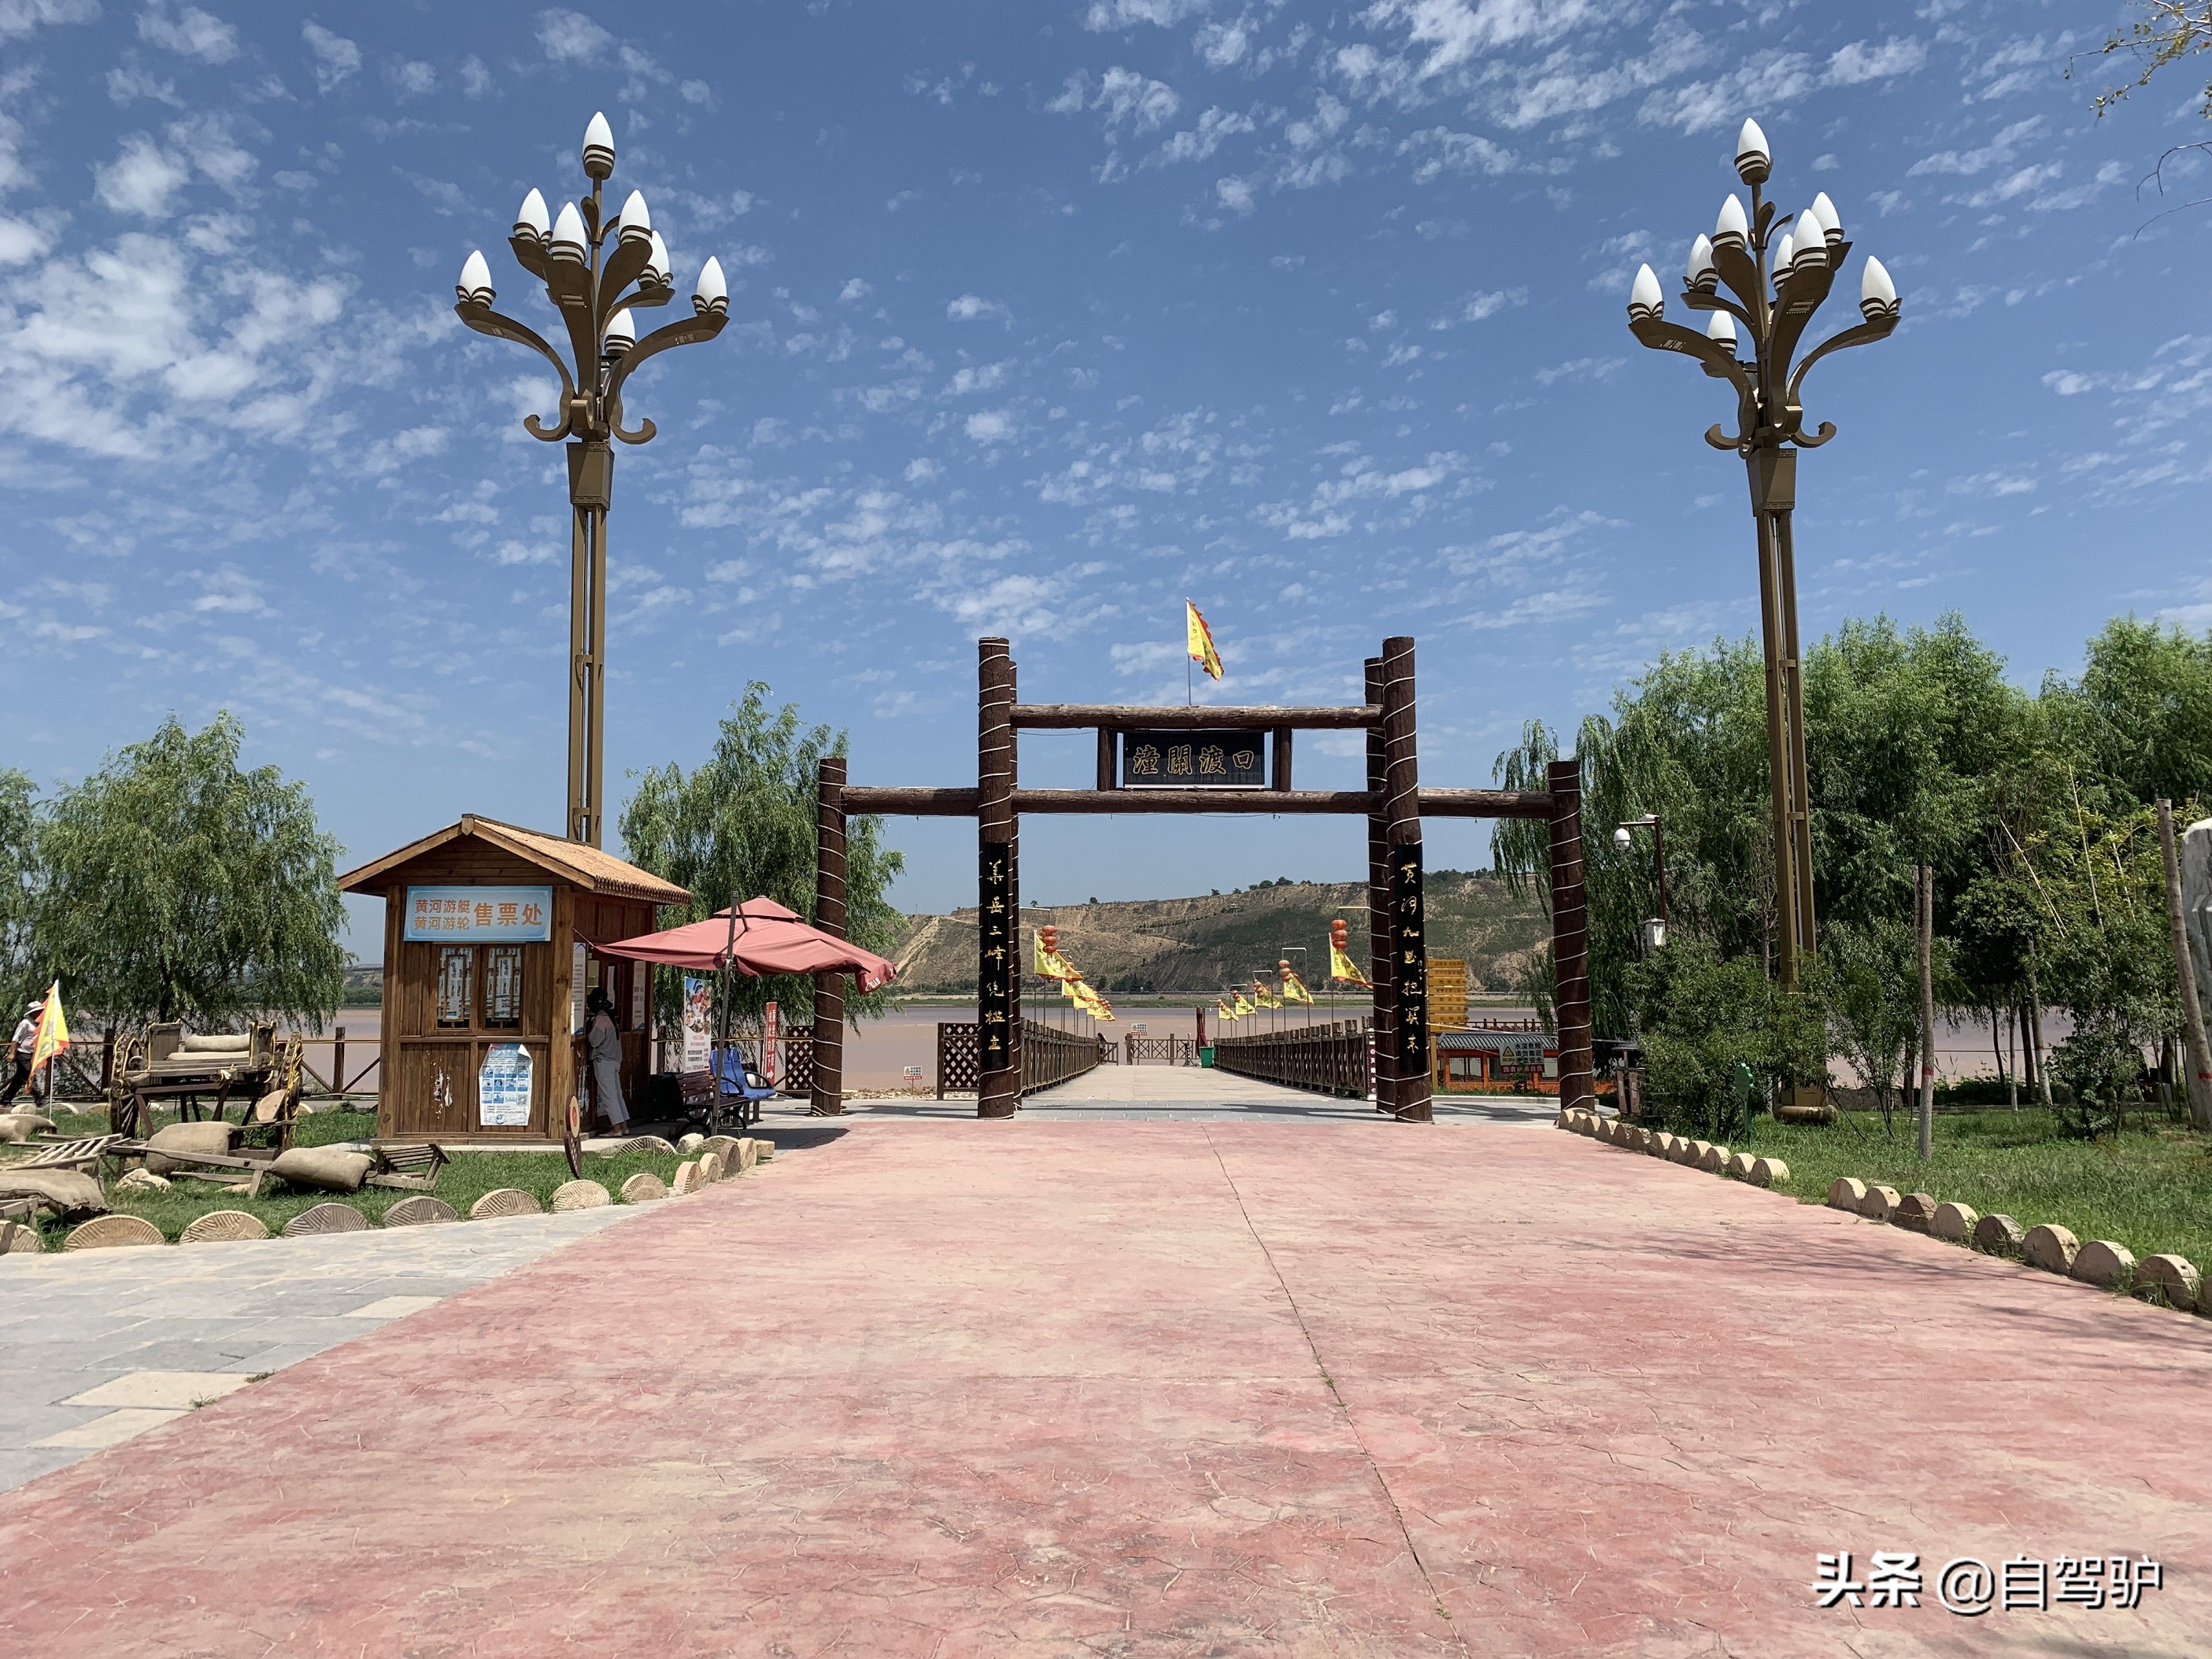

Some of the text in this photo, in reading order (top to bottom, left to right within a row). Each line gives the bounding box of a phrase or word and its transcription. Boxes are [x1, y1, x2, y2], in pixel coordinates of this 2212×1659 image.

[415, 899, 471, 914] 黄河游艇
[473, 902, 543, 927] 售票处
[414, 916, 470, 931] 黄河游轮
